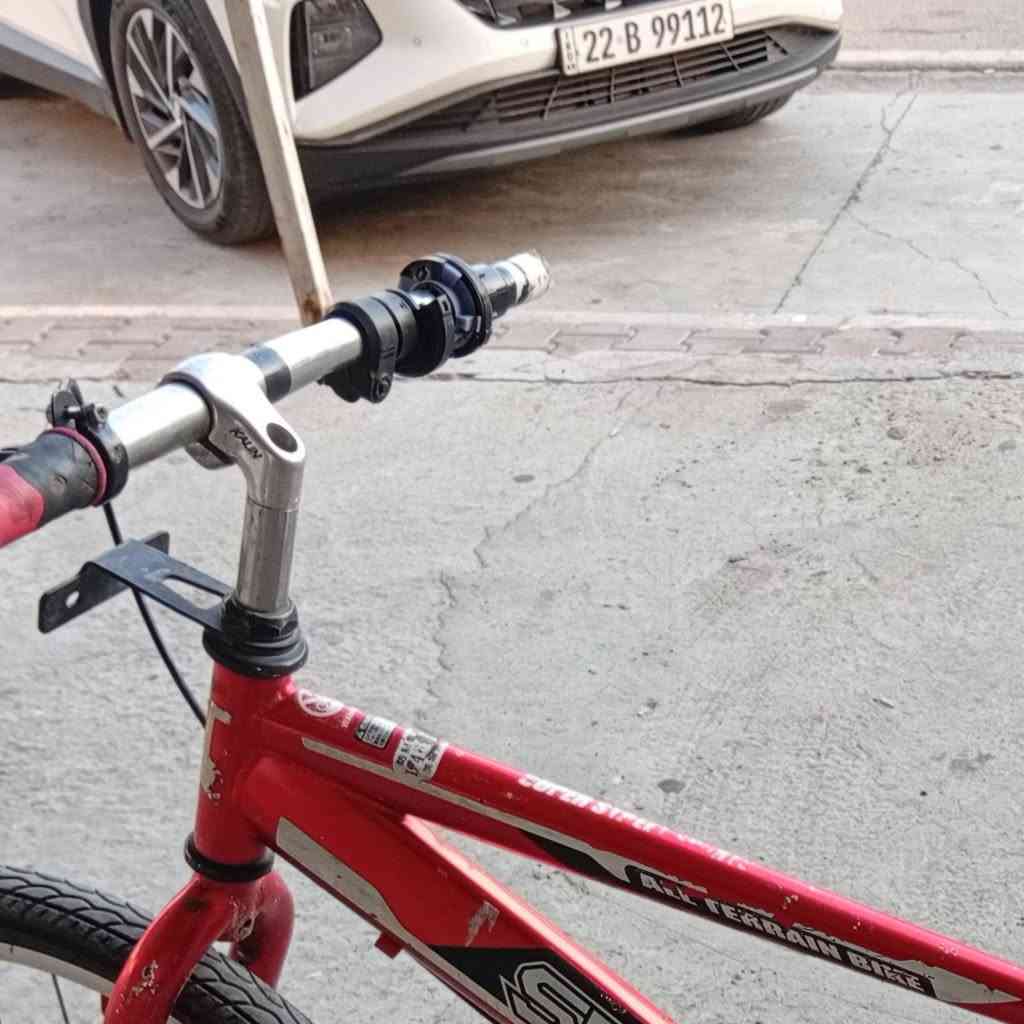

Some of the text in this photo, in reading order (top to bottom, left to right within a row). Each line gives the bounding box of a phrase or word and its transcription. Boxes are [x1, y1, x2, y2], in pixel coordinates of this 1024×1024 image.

[583, 27, 616, 63] 22
[624, 21, 642, 54] B
[651, 3, 727, 48] 99112
[704, 897, 843, 961] TERRAIN
[849, 950, 924, 992] BIKE
